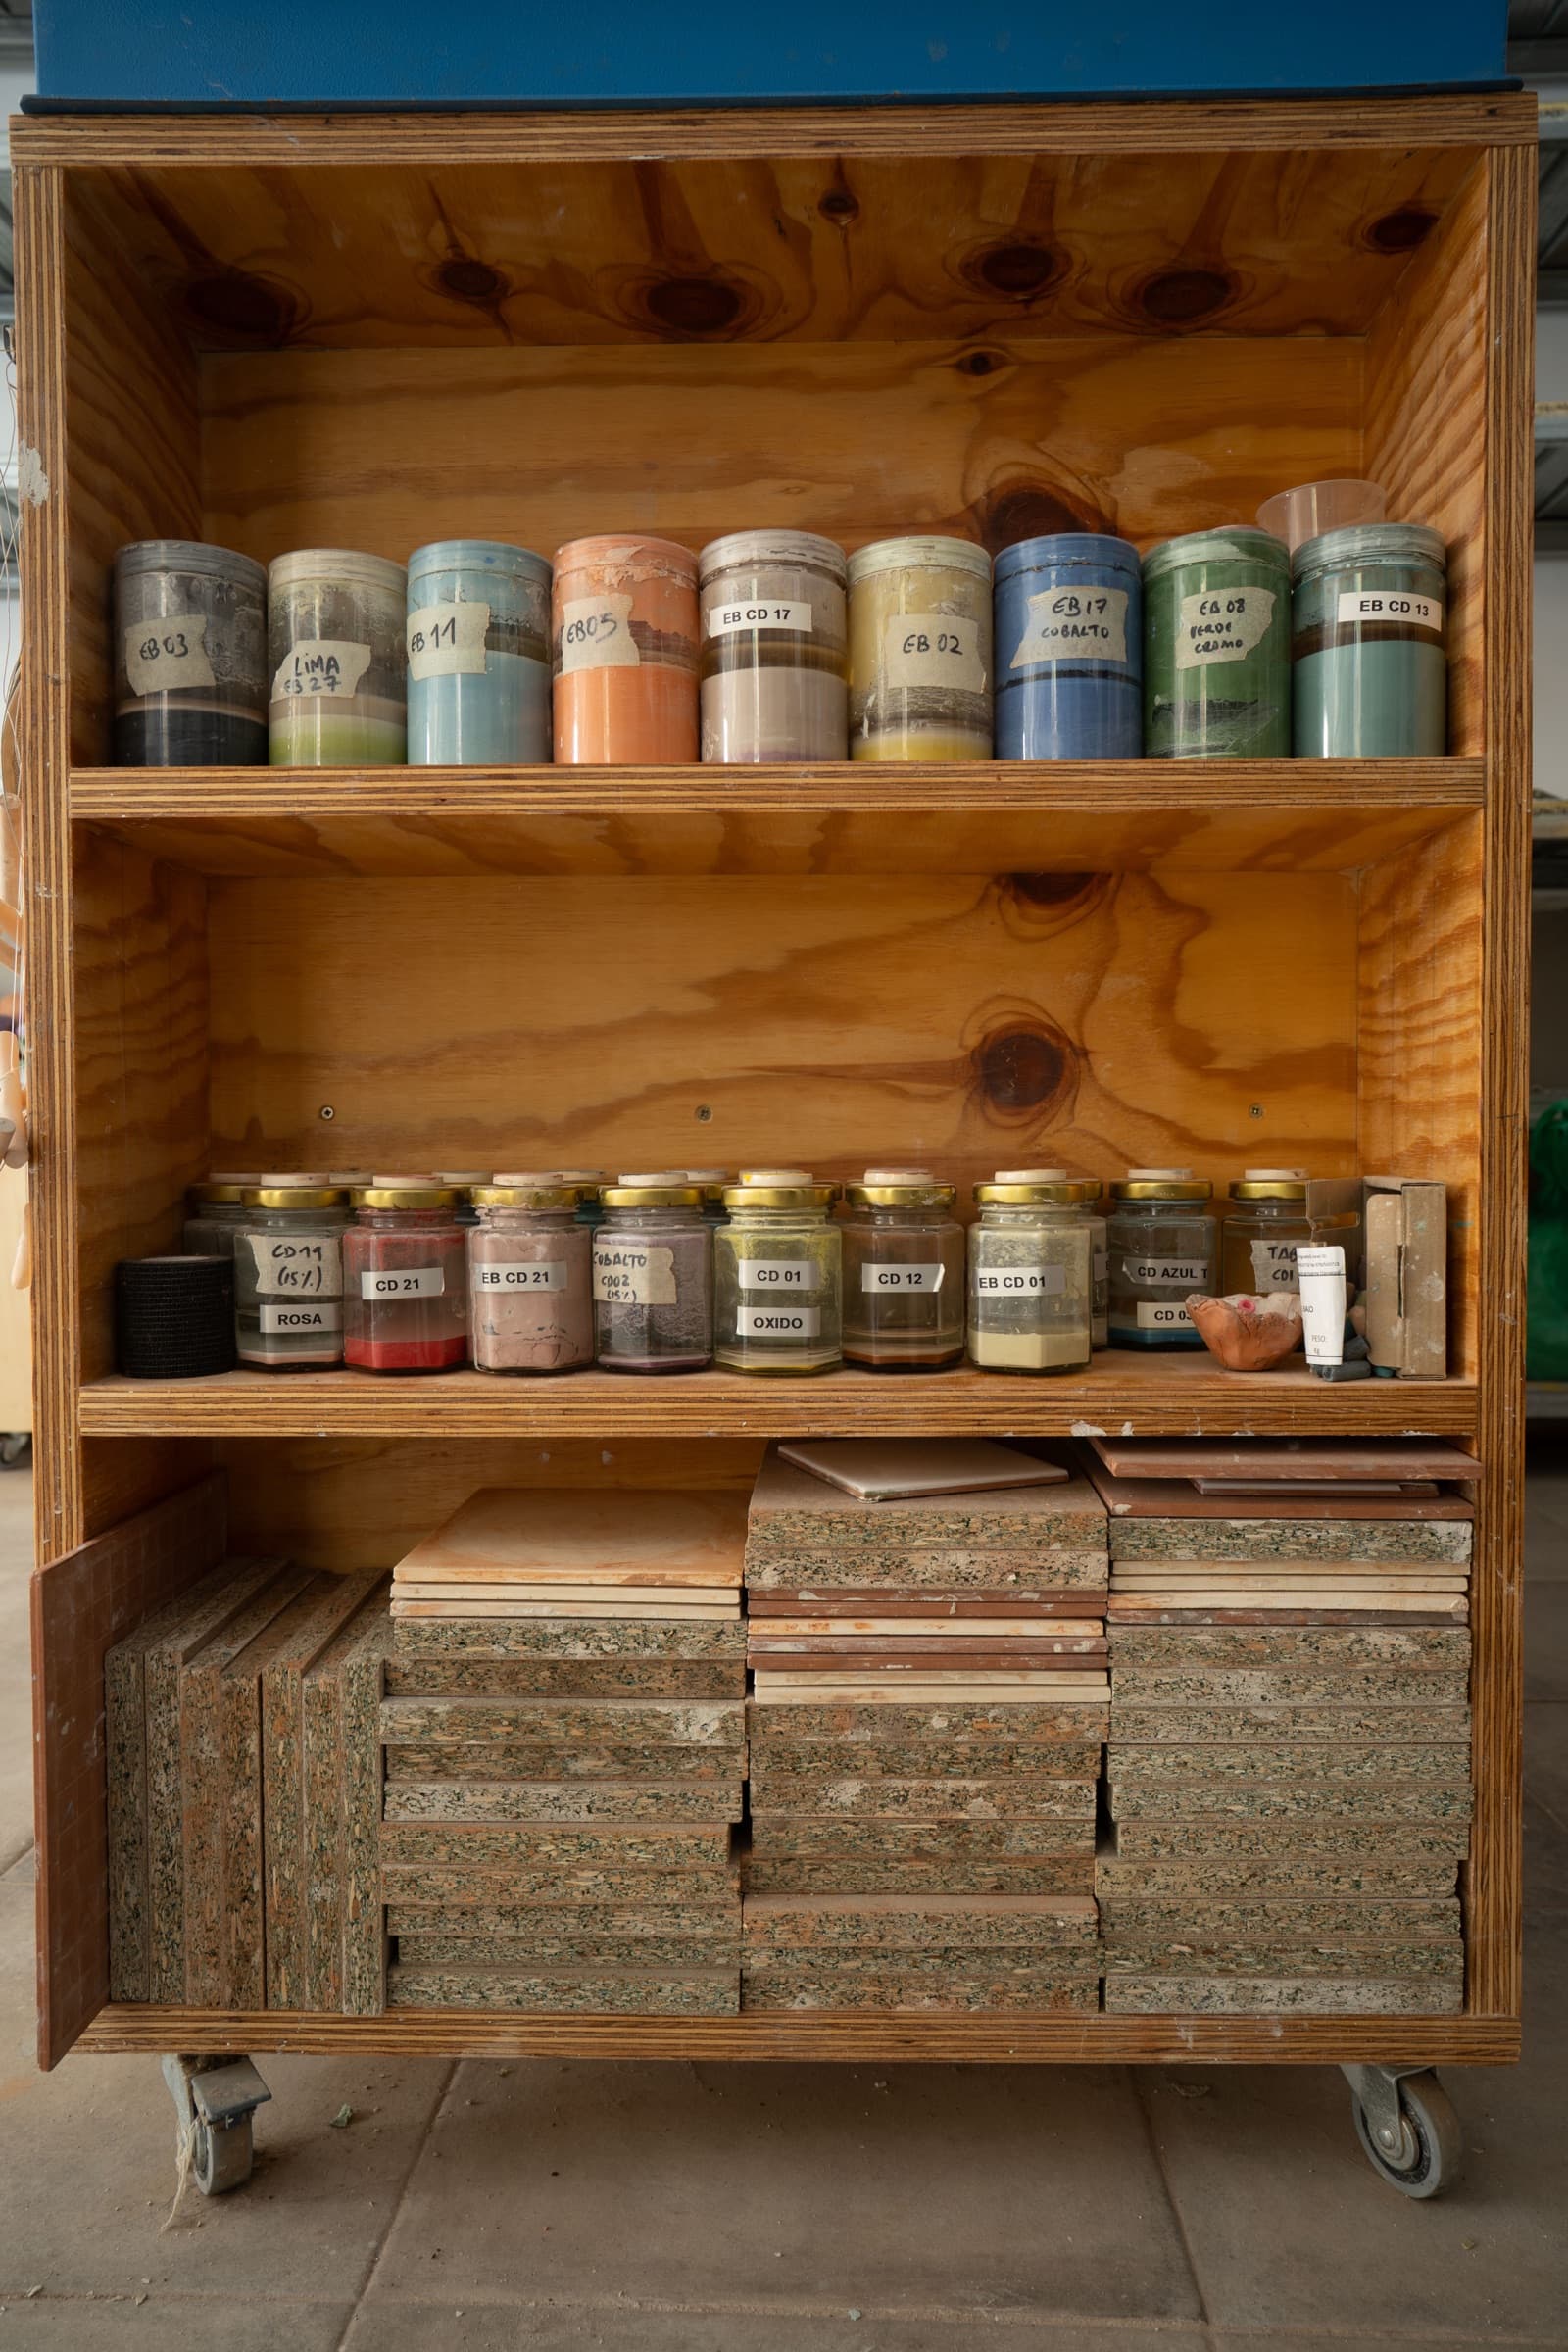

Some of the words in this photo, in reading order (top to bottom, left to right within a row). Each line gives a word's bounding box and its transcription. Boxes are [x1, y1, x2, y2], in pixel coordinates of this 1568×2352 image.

[1199, 601, 1220, 616] EB
[1359, 600, 1383, 612] EB
[1389, 601, 1411, 613] CD
[1415, 604, 1429, 617] 13
[723, 611, 742, 625] EB
[746, 609, 768, 621] CD
[773, 609, 791, 620] 17
[1041, 624, 1109, 639] COBALTO
[1190, 622, 1232, 640] VERDE
[903, 634, 930, 654] EB
[937, 633, 963, 656] 02
[1194, 639, 1244, 654] CROMO
[481, 1272, 501, 1285] EB
[505, 1272, 527, 1284] CD
[532, 1272, 550, 1284] 21
[757, 1270, 780, 1283] CD
[784, 1270, 802, 1282] 01
[878, 1273, 901, 1285] CD
[906, 1273, 923, 1285] 12
[1138, 1266, 1157, 1278] CD
[1161, 1267, 1198, 1279] AZUL
[375, 1279, 400, 1292] CD
[403, 1278, 420, 1290] 21
[979, 1277, 998, 1289] EB
[1003, 1276, 1025, 1288] CD
[1029, 1276, 1047, 1288] 01
[277, 1313, 322, 1326] ROSA
[1154, 1310, 1174, 1321] CD
[753, 1316, 804, 1330] OXIDO
